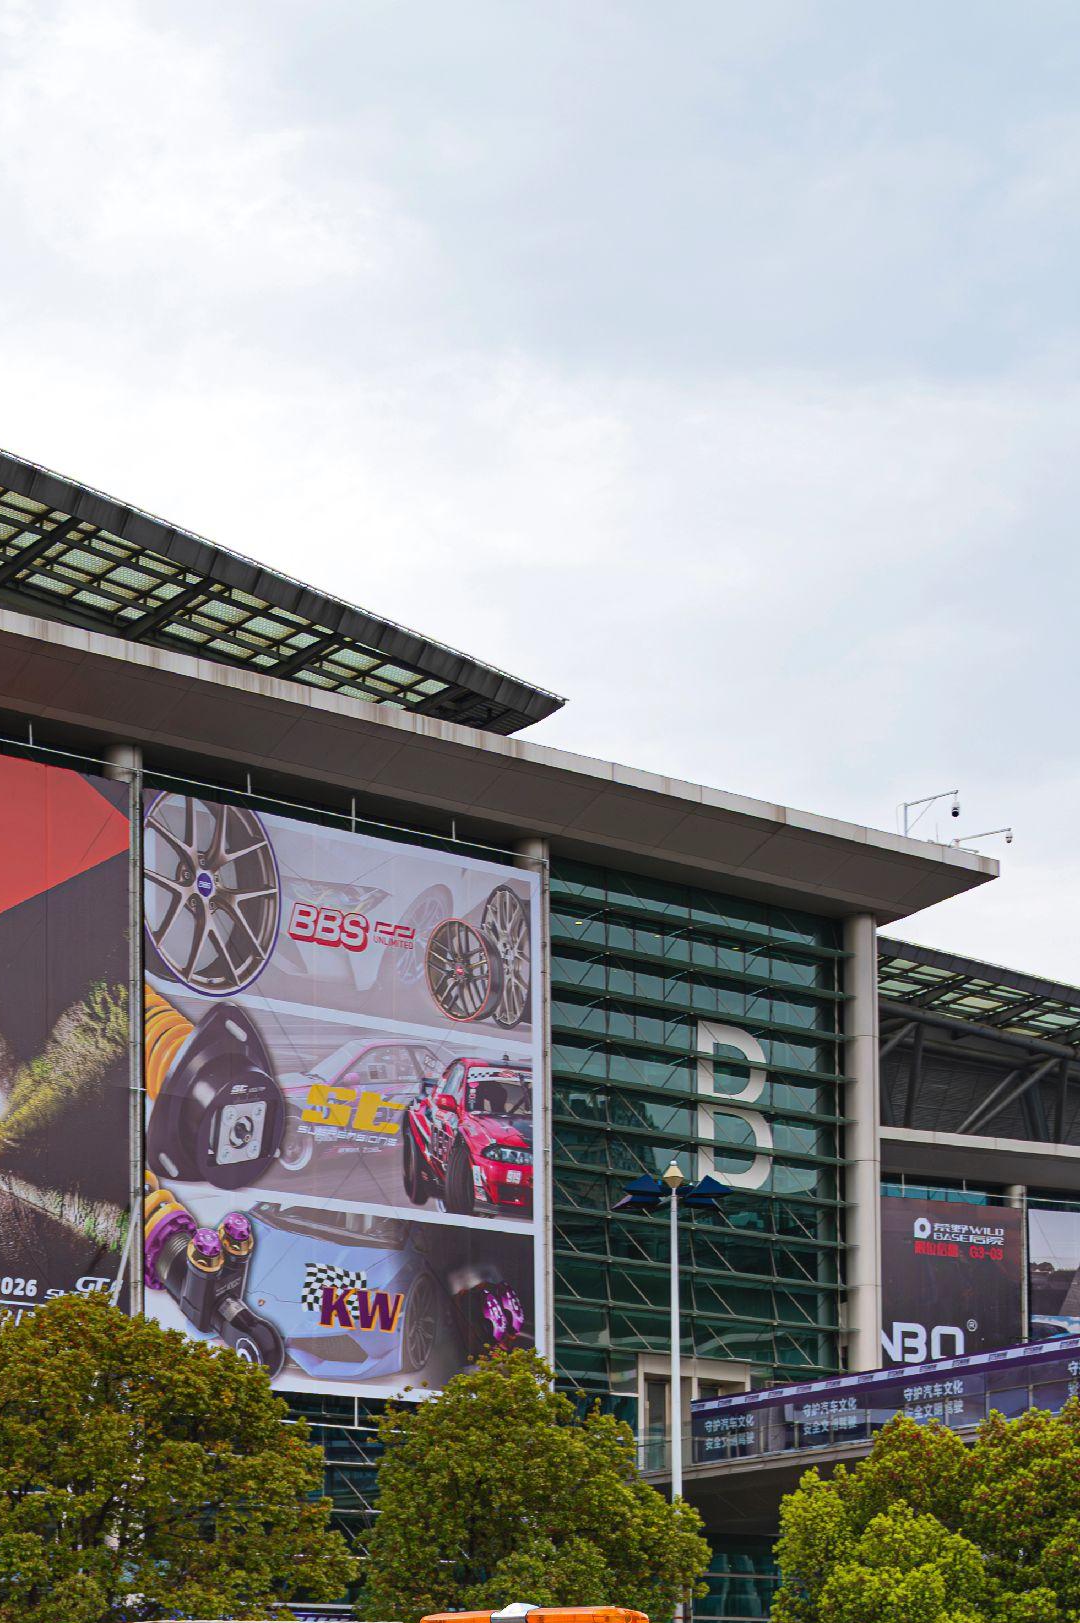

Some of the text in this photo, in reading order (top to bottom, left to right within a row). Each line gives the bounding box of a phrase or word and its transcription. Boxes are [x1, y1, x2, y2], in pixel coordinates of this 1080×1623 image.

[287, 902, 369, 952] BBS
[697, 1020, 774, 1190] B
[318, 1286, 404, 1334] KW
[802, 1397, 857, 1419] 守护汽车文化
[903, 1379, 964, 1403] 守护汽车文化
[704, 1413, 755, 1432] 守护汽车文化
